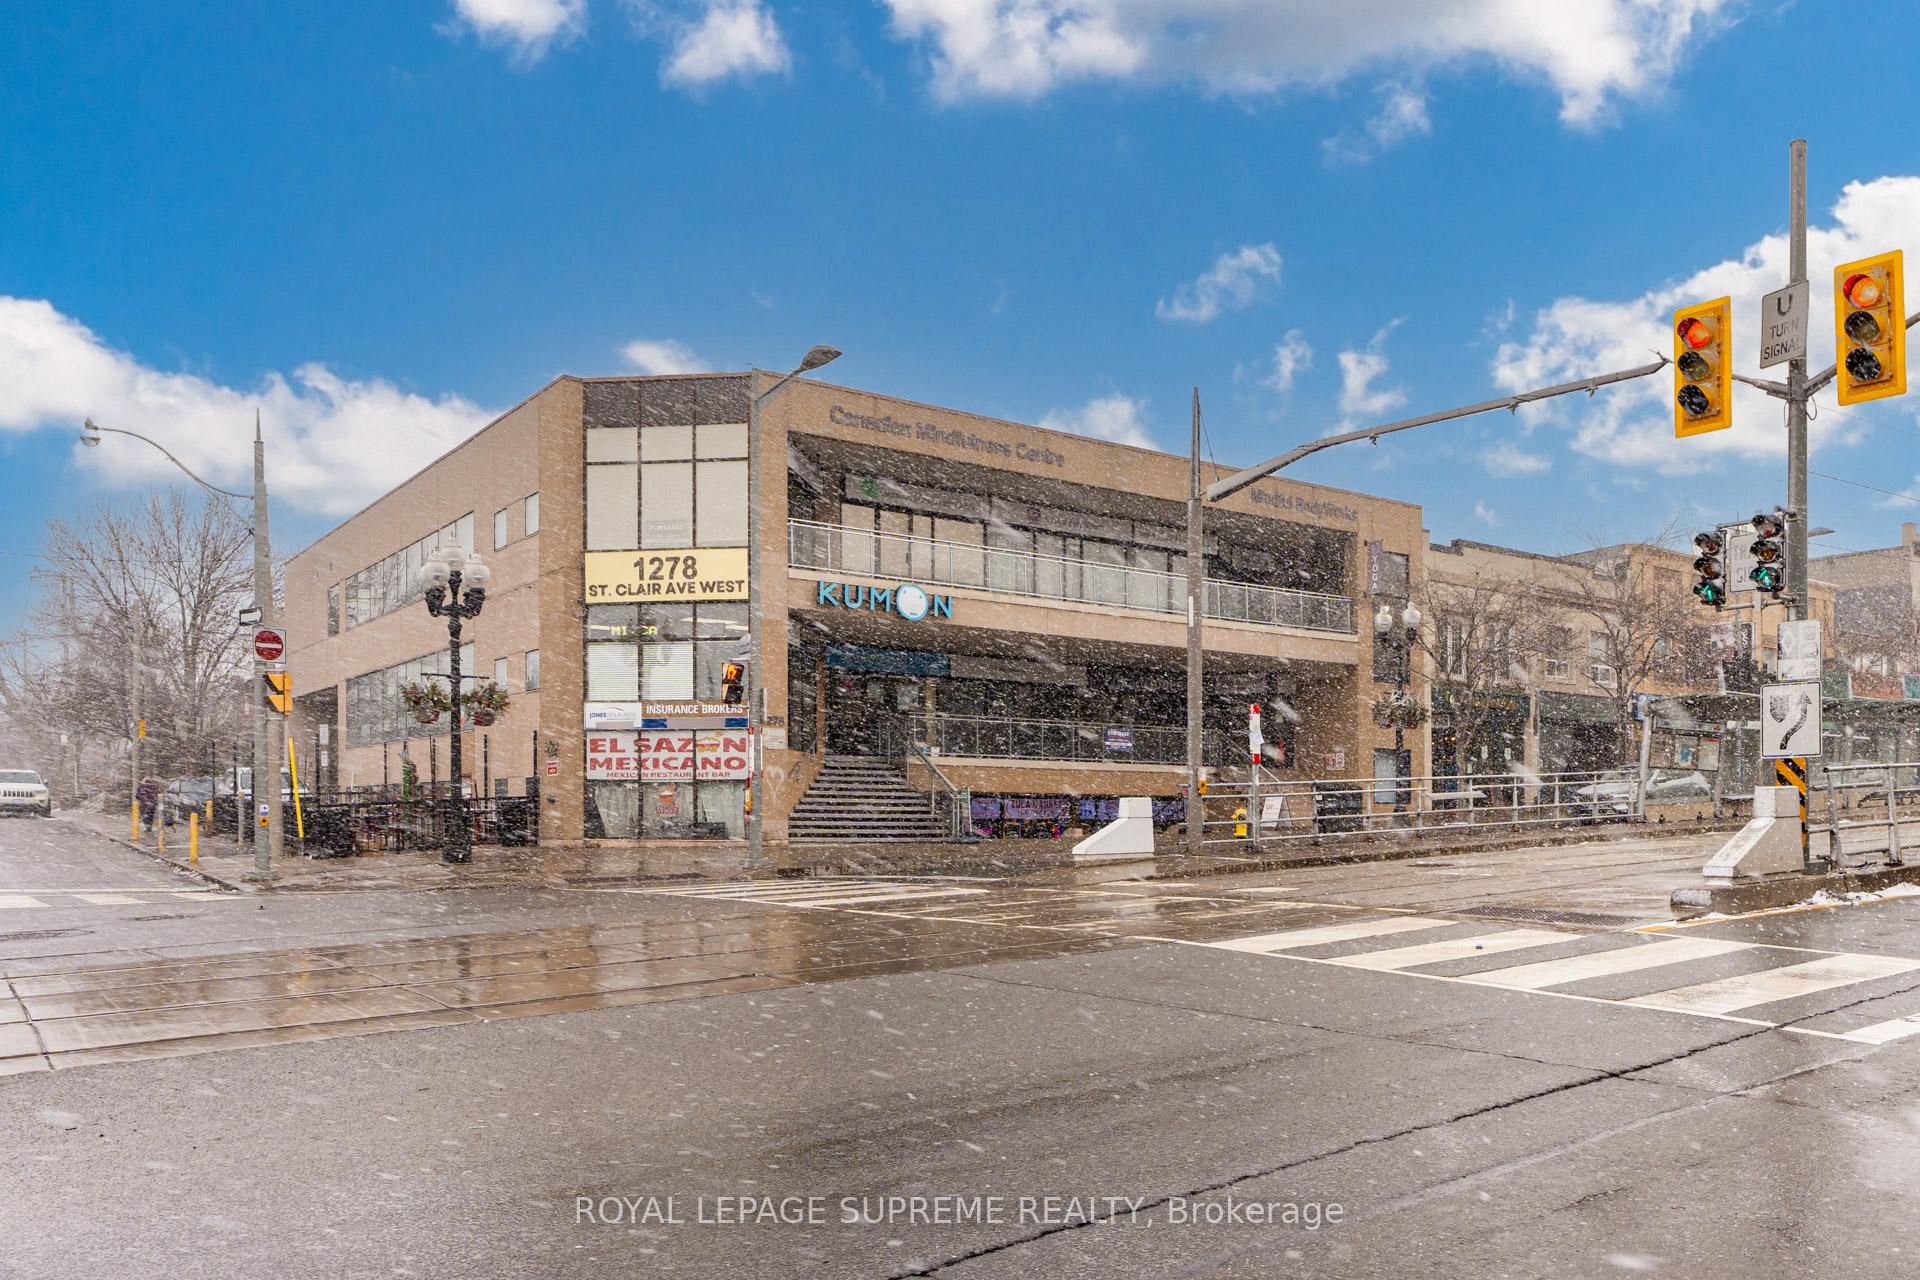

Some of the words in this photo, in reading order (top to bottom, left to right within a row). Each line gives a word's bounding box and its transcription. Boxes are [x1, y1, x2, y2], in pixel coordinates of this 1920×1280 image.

[1777, 293, 1793, 316] U
[1770, 319, 1800, 338] TURN
[1764, 337, 1801, 360] SIGNAL
[633, 555, 698, 581] 1278
[1371, 555, 1379, 590] YOGA
[589, 584, 612, 597] ST.
[615, 582, 662, 596] CLAIR
[665, 581, 696, 595] AVE
[700, 580, 745, 594] WEST
[817, 579, 954, 622] KUMON
[646, 704, 699, 715] INSURANCE
[702, 704, 743, 714] BROKERS
[589, 738, 626, 753] EL
[633, 736, 747, 753] SAZN
[589, 756, 747, 771] MEXICANO
